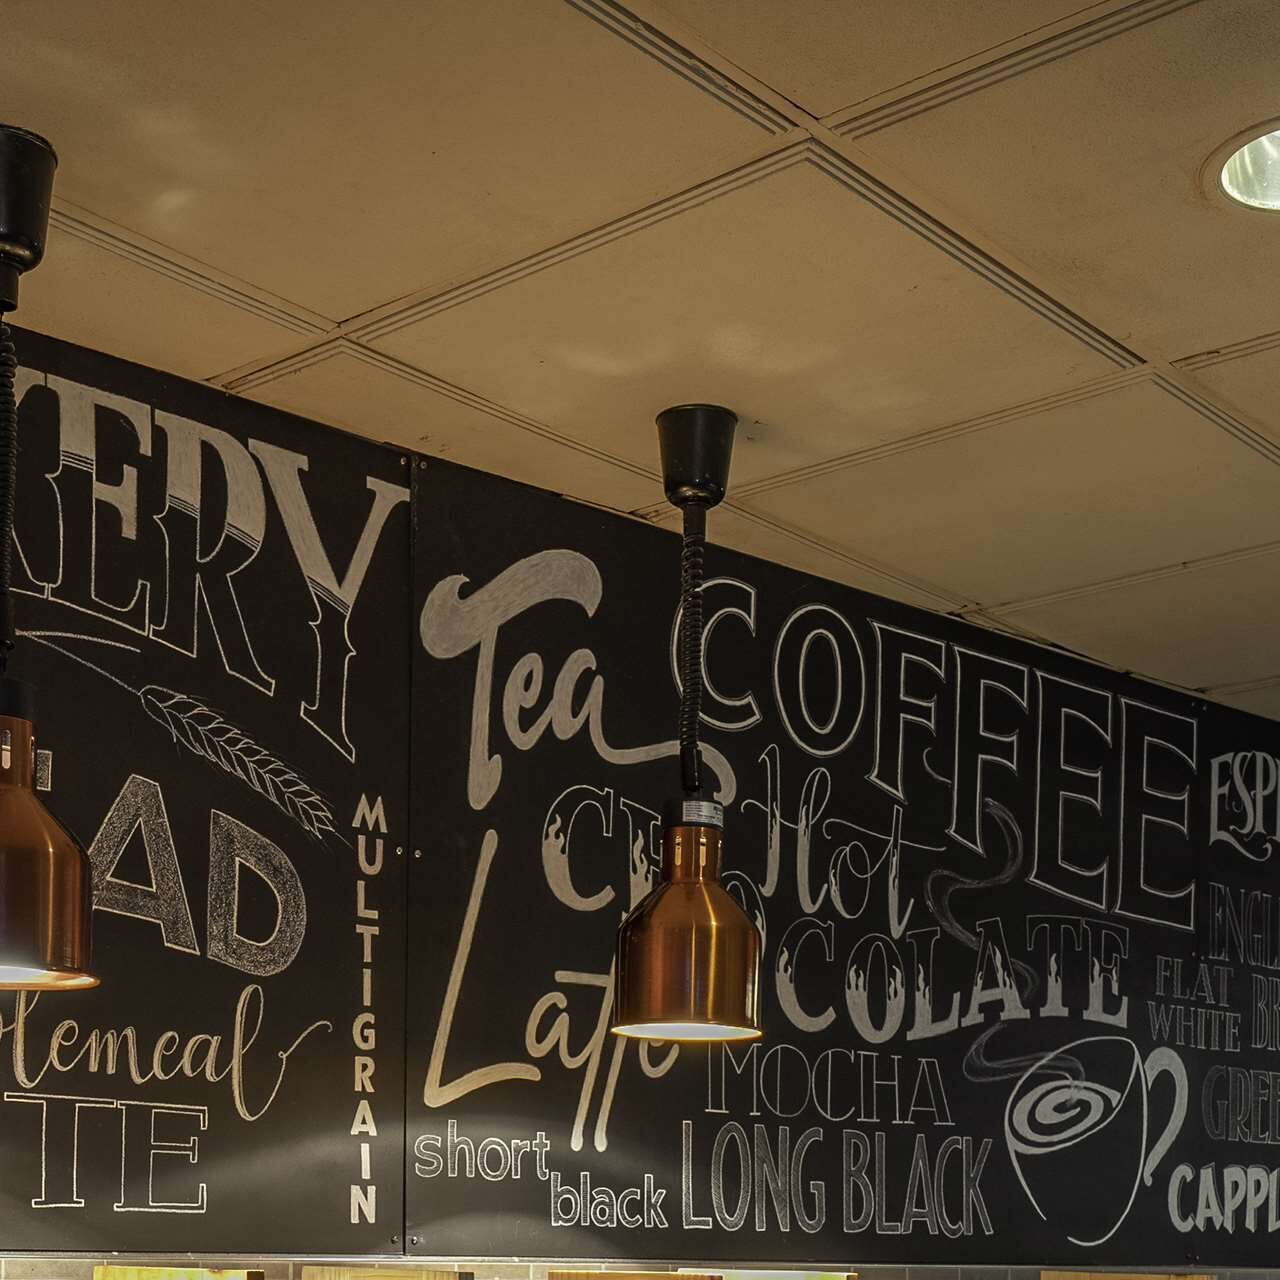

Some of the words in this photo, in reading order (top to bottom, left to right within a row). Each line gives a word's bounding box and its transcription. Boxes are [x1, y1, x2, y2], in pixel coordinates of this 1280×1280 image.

[420, 549, 737, 811] Tea
[671, 576, 1199, 932] COFFEE
[741, 744, 947, 939] Hot
[541, 784, 1129, 1045] CCOLATE
[350, 793, 389, 1225] MULTIGRAIN
[1146, 1000, 1242, 1053] WHITE
[1154, 954, 1235, 1008] FLAT
[704, 1041, 957, 1127] MOCHA
[415, 1119, 552, 1182] short
[549, 1170, 669, 1229] black
[681, 1120, 827, 1233] LONG
[843, 1126, 996, 1241] BLACK
